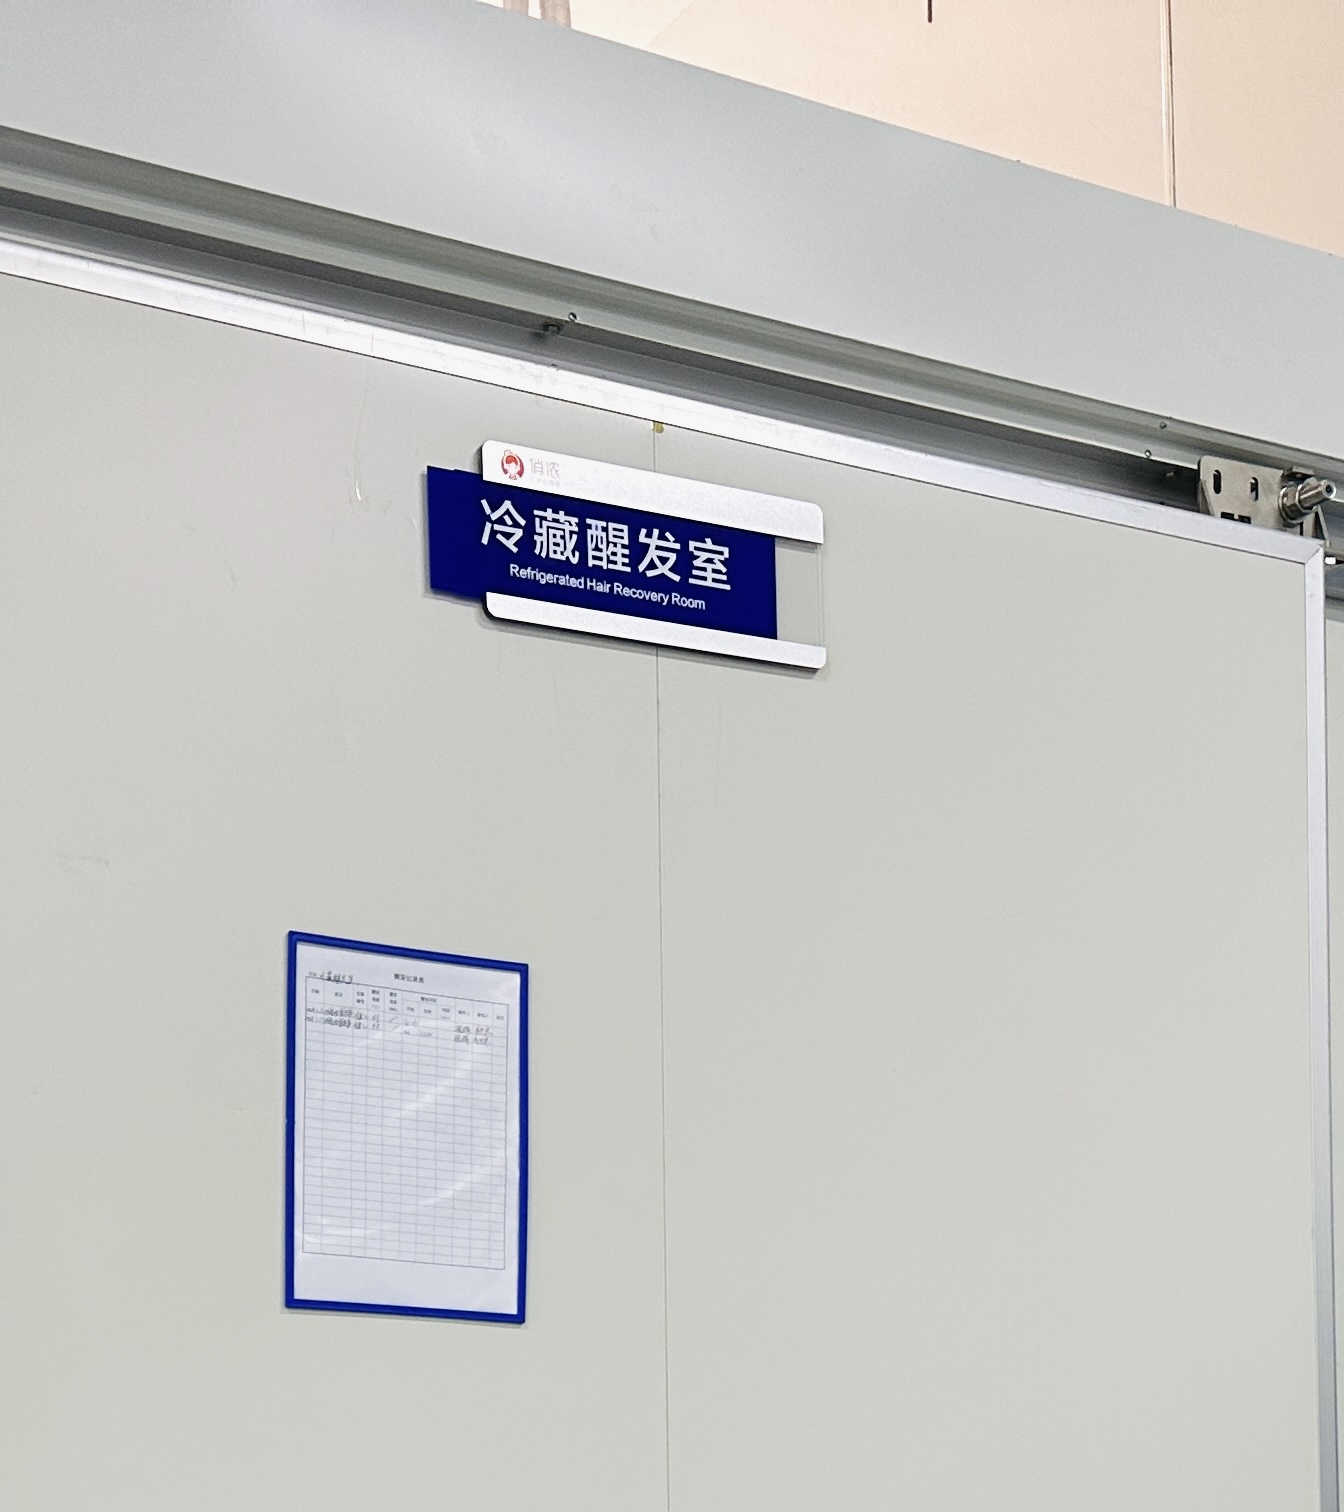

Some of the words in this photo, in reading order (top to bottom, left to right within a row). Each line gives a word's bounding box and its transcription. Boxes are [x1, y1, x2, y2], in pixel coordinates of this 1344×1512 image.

[480, 498, 732, 591] 冷藏醒发室
[509, 563, 585, 589] Refrigerated
[586, 577, 612, 594] Hair
[613, 582, 670, 606] Recovery
[671, 591, 706, 610] Room
